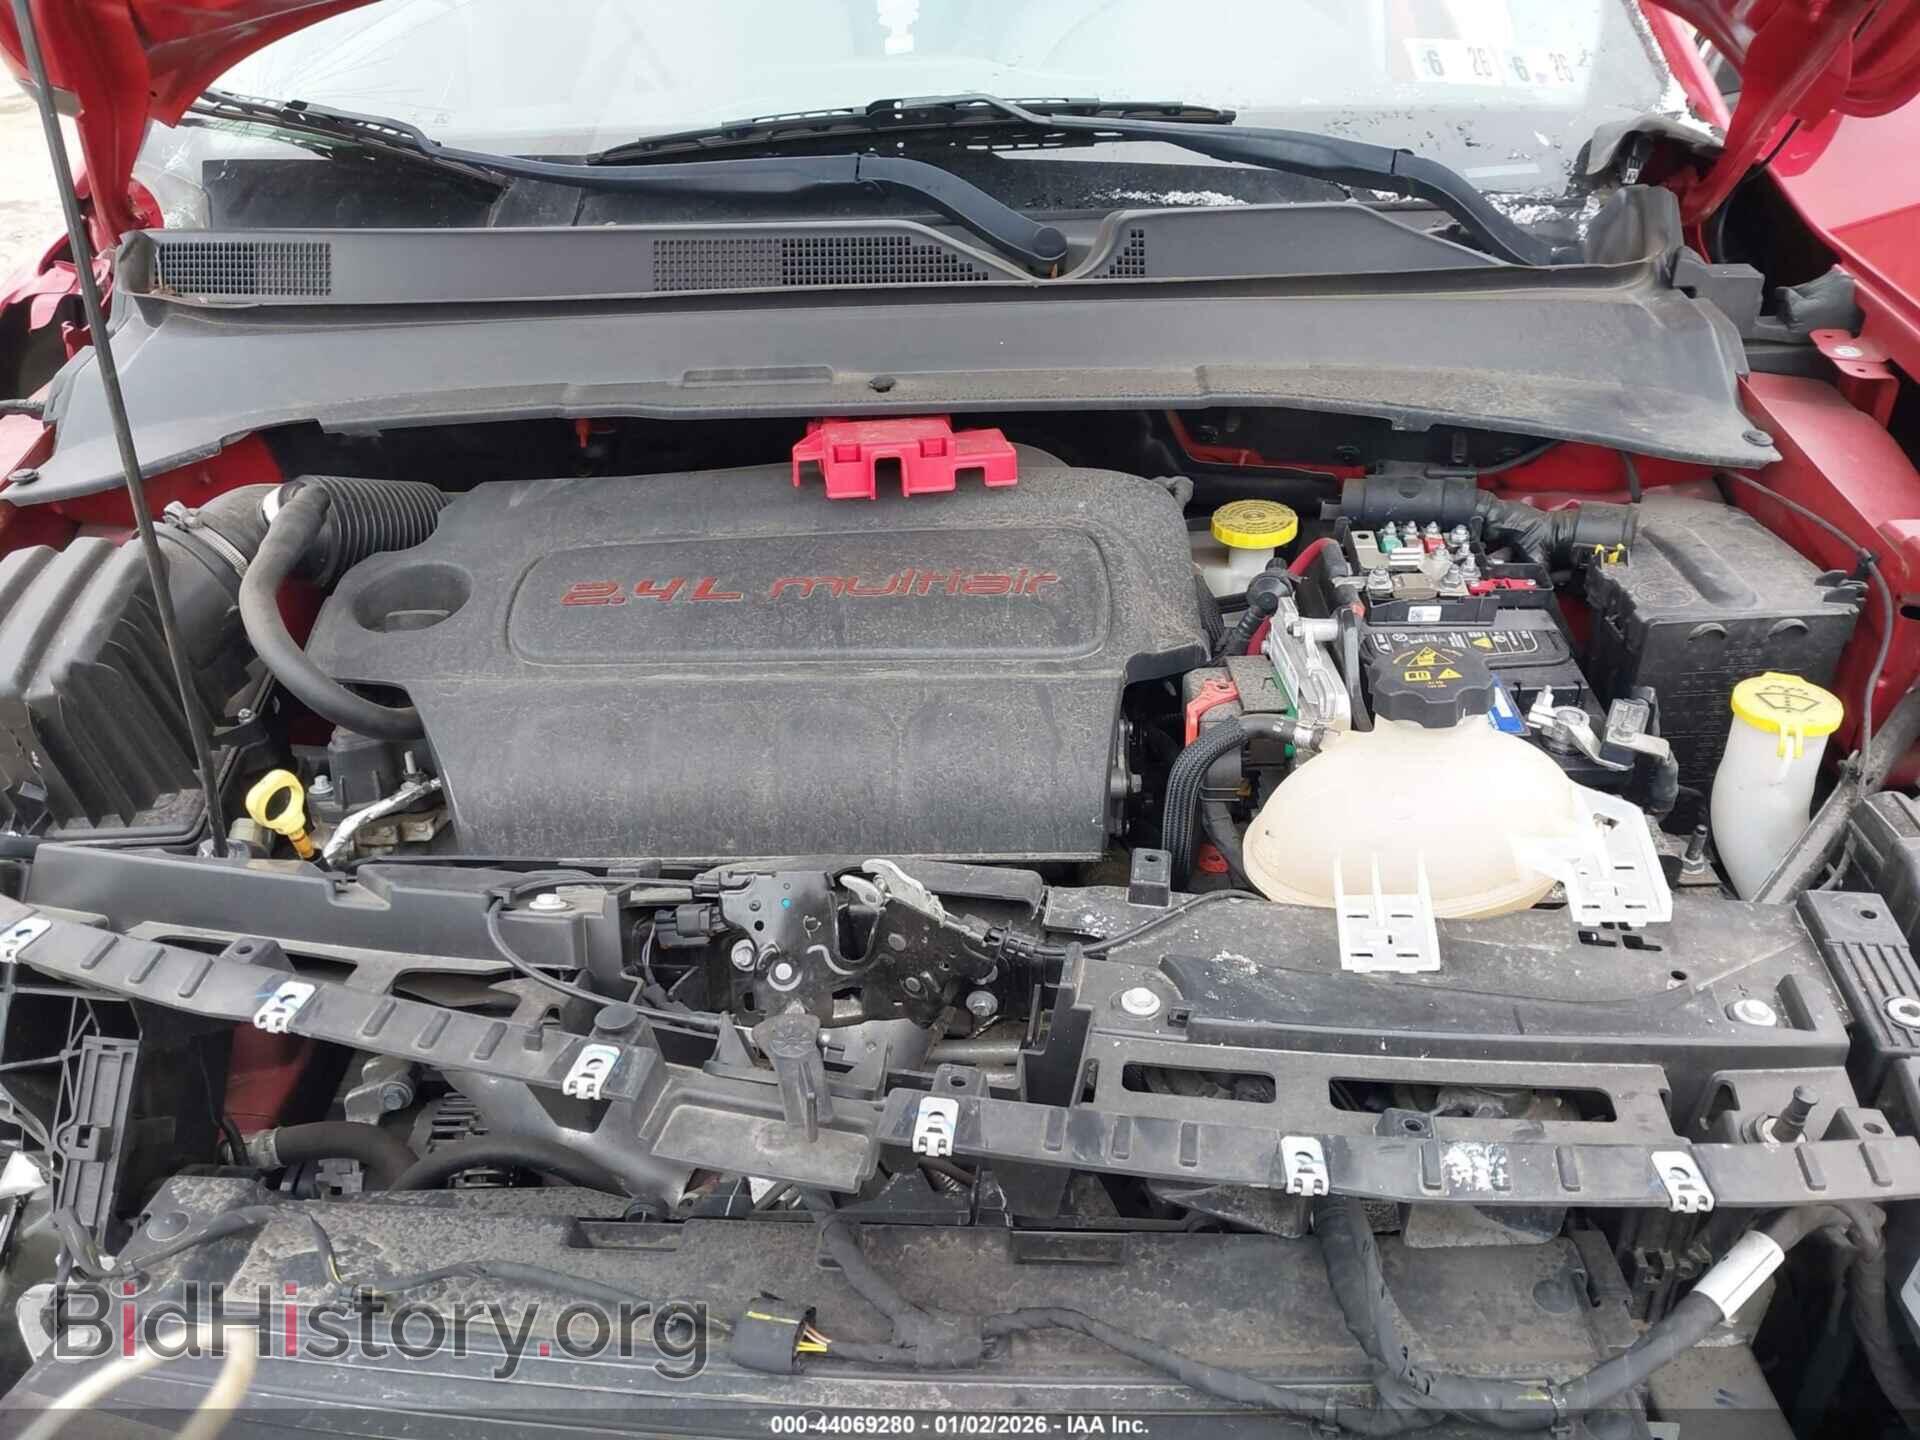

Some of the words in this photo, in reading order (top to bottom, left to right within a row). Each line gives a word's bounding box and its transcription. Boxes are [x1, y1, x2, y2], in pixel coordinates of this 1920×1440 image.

[1425, 49, 1445, 77] 6
[1512, 55, 1531, 82] 6
[560, 576, 744, 607] 2.4L
[769, 567, 1059, 599] multiair
